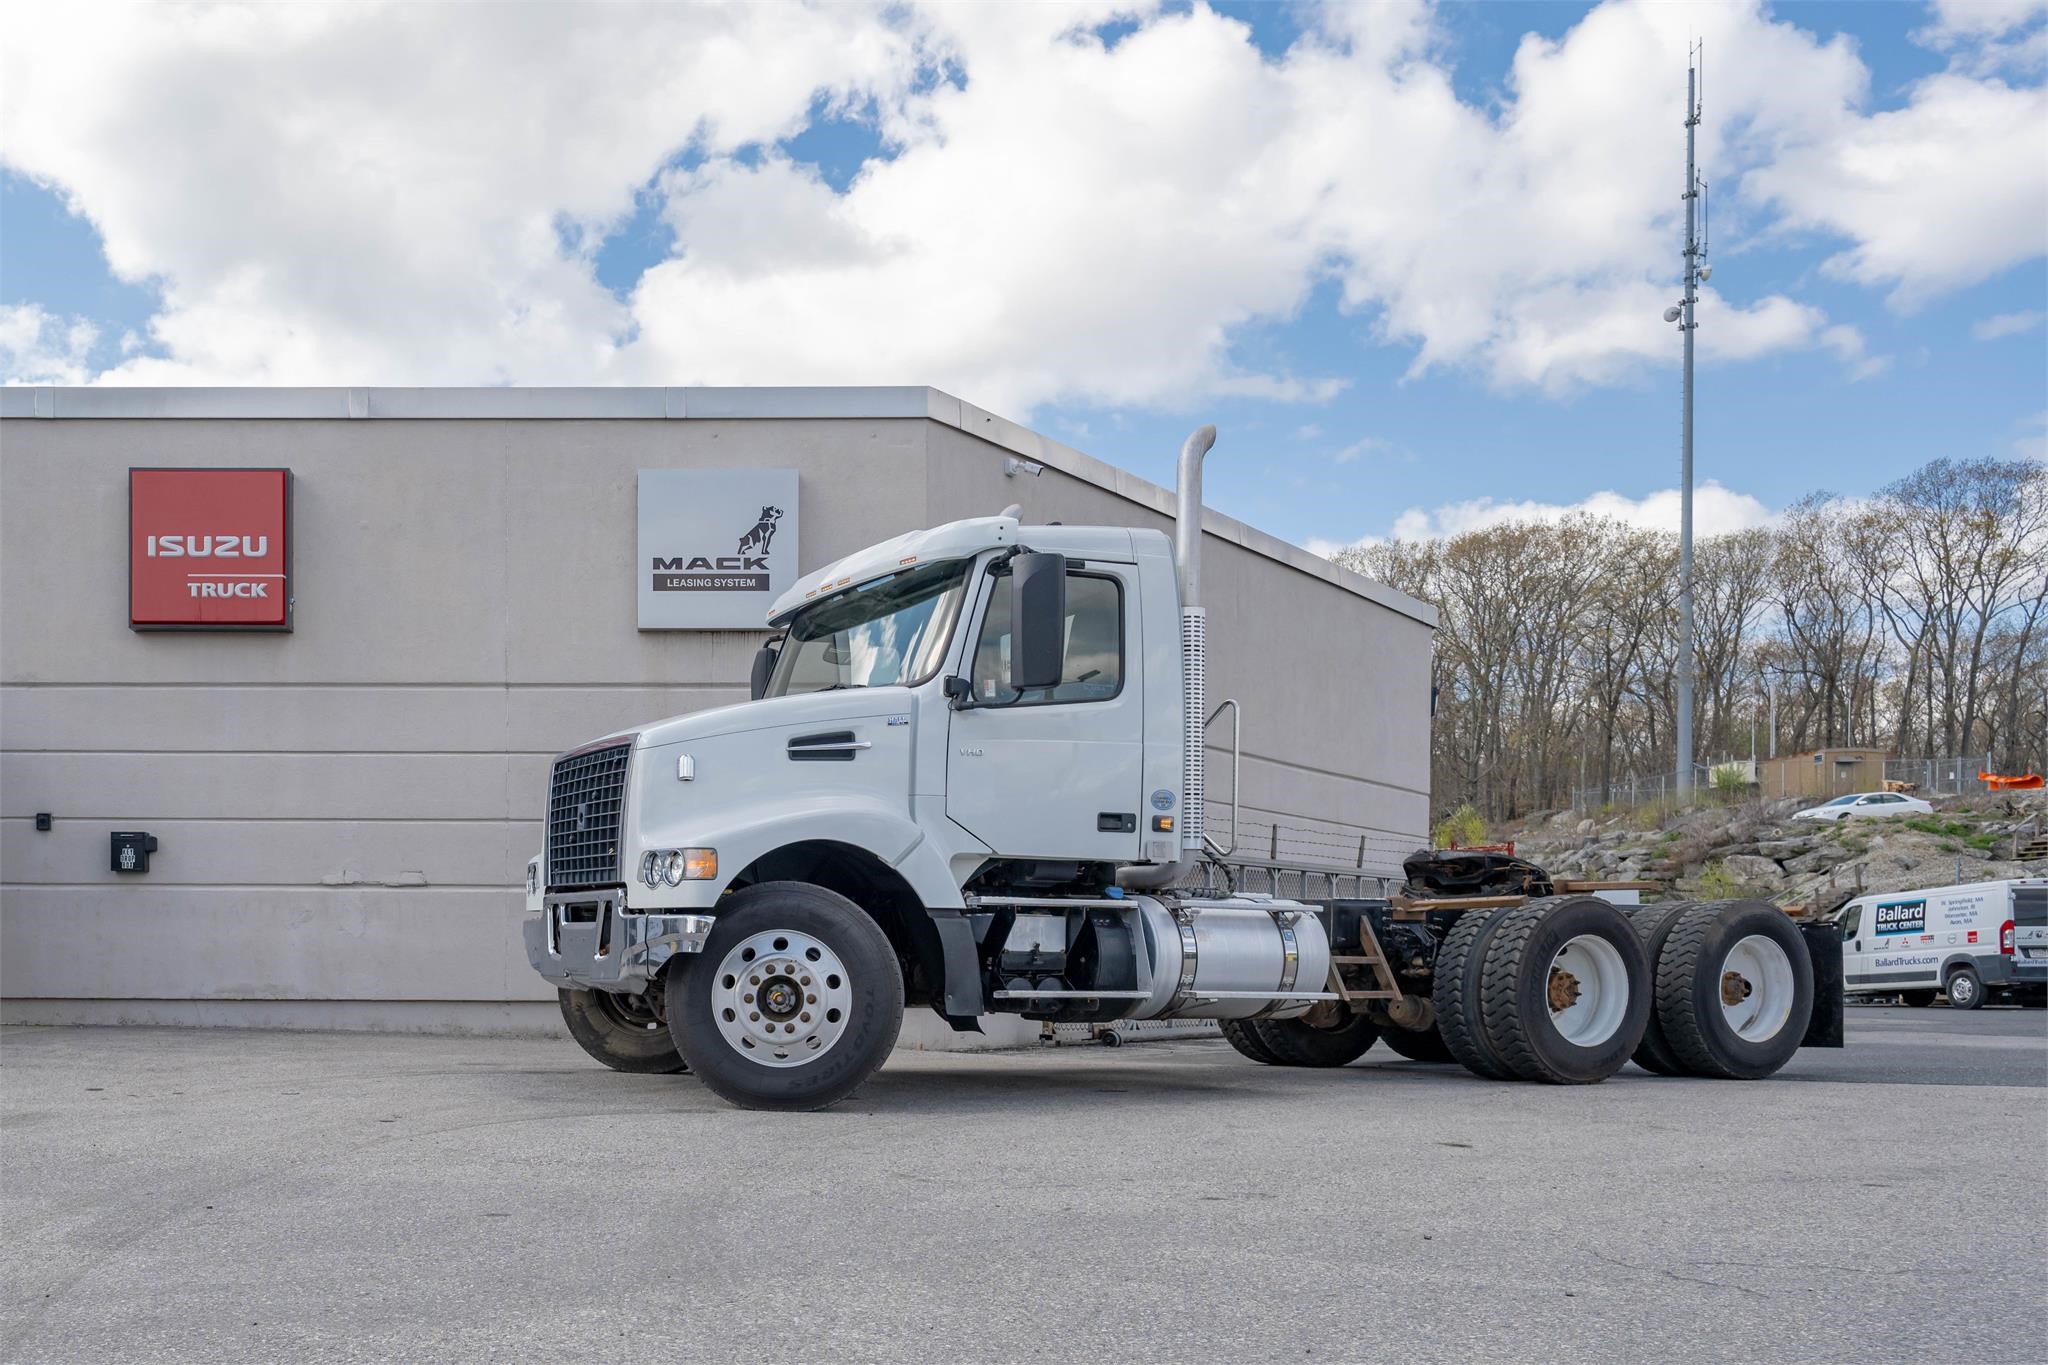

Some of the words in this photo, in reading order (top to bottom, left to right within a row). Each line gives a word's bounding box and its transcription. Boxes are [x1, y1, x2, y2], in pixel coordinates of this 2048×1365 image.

[147, 535, 268, 557] ISUZU
[653, 557, 769, 570] MACK
[667, 579, 712, 587] LEASING
[714, 579, 756, 587] SYSTEM
[187, 582, 268, 598] TRUCK
[960, 748, 984, 757] VHD
[1878, 903, 1923, 922] Ballard
[1877, 922, 1898, 932] TRUCK
[1899, 920, 1924, 930] CENTER
[1875, 956, 1939, 967] BallardTrucks.com
